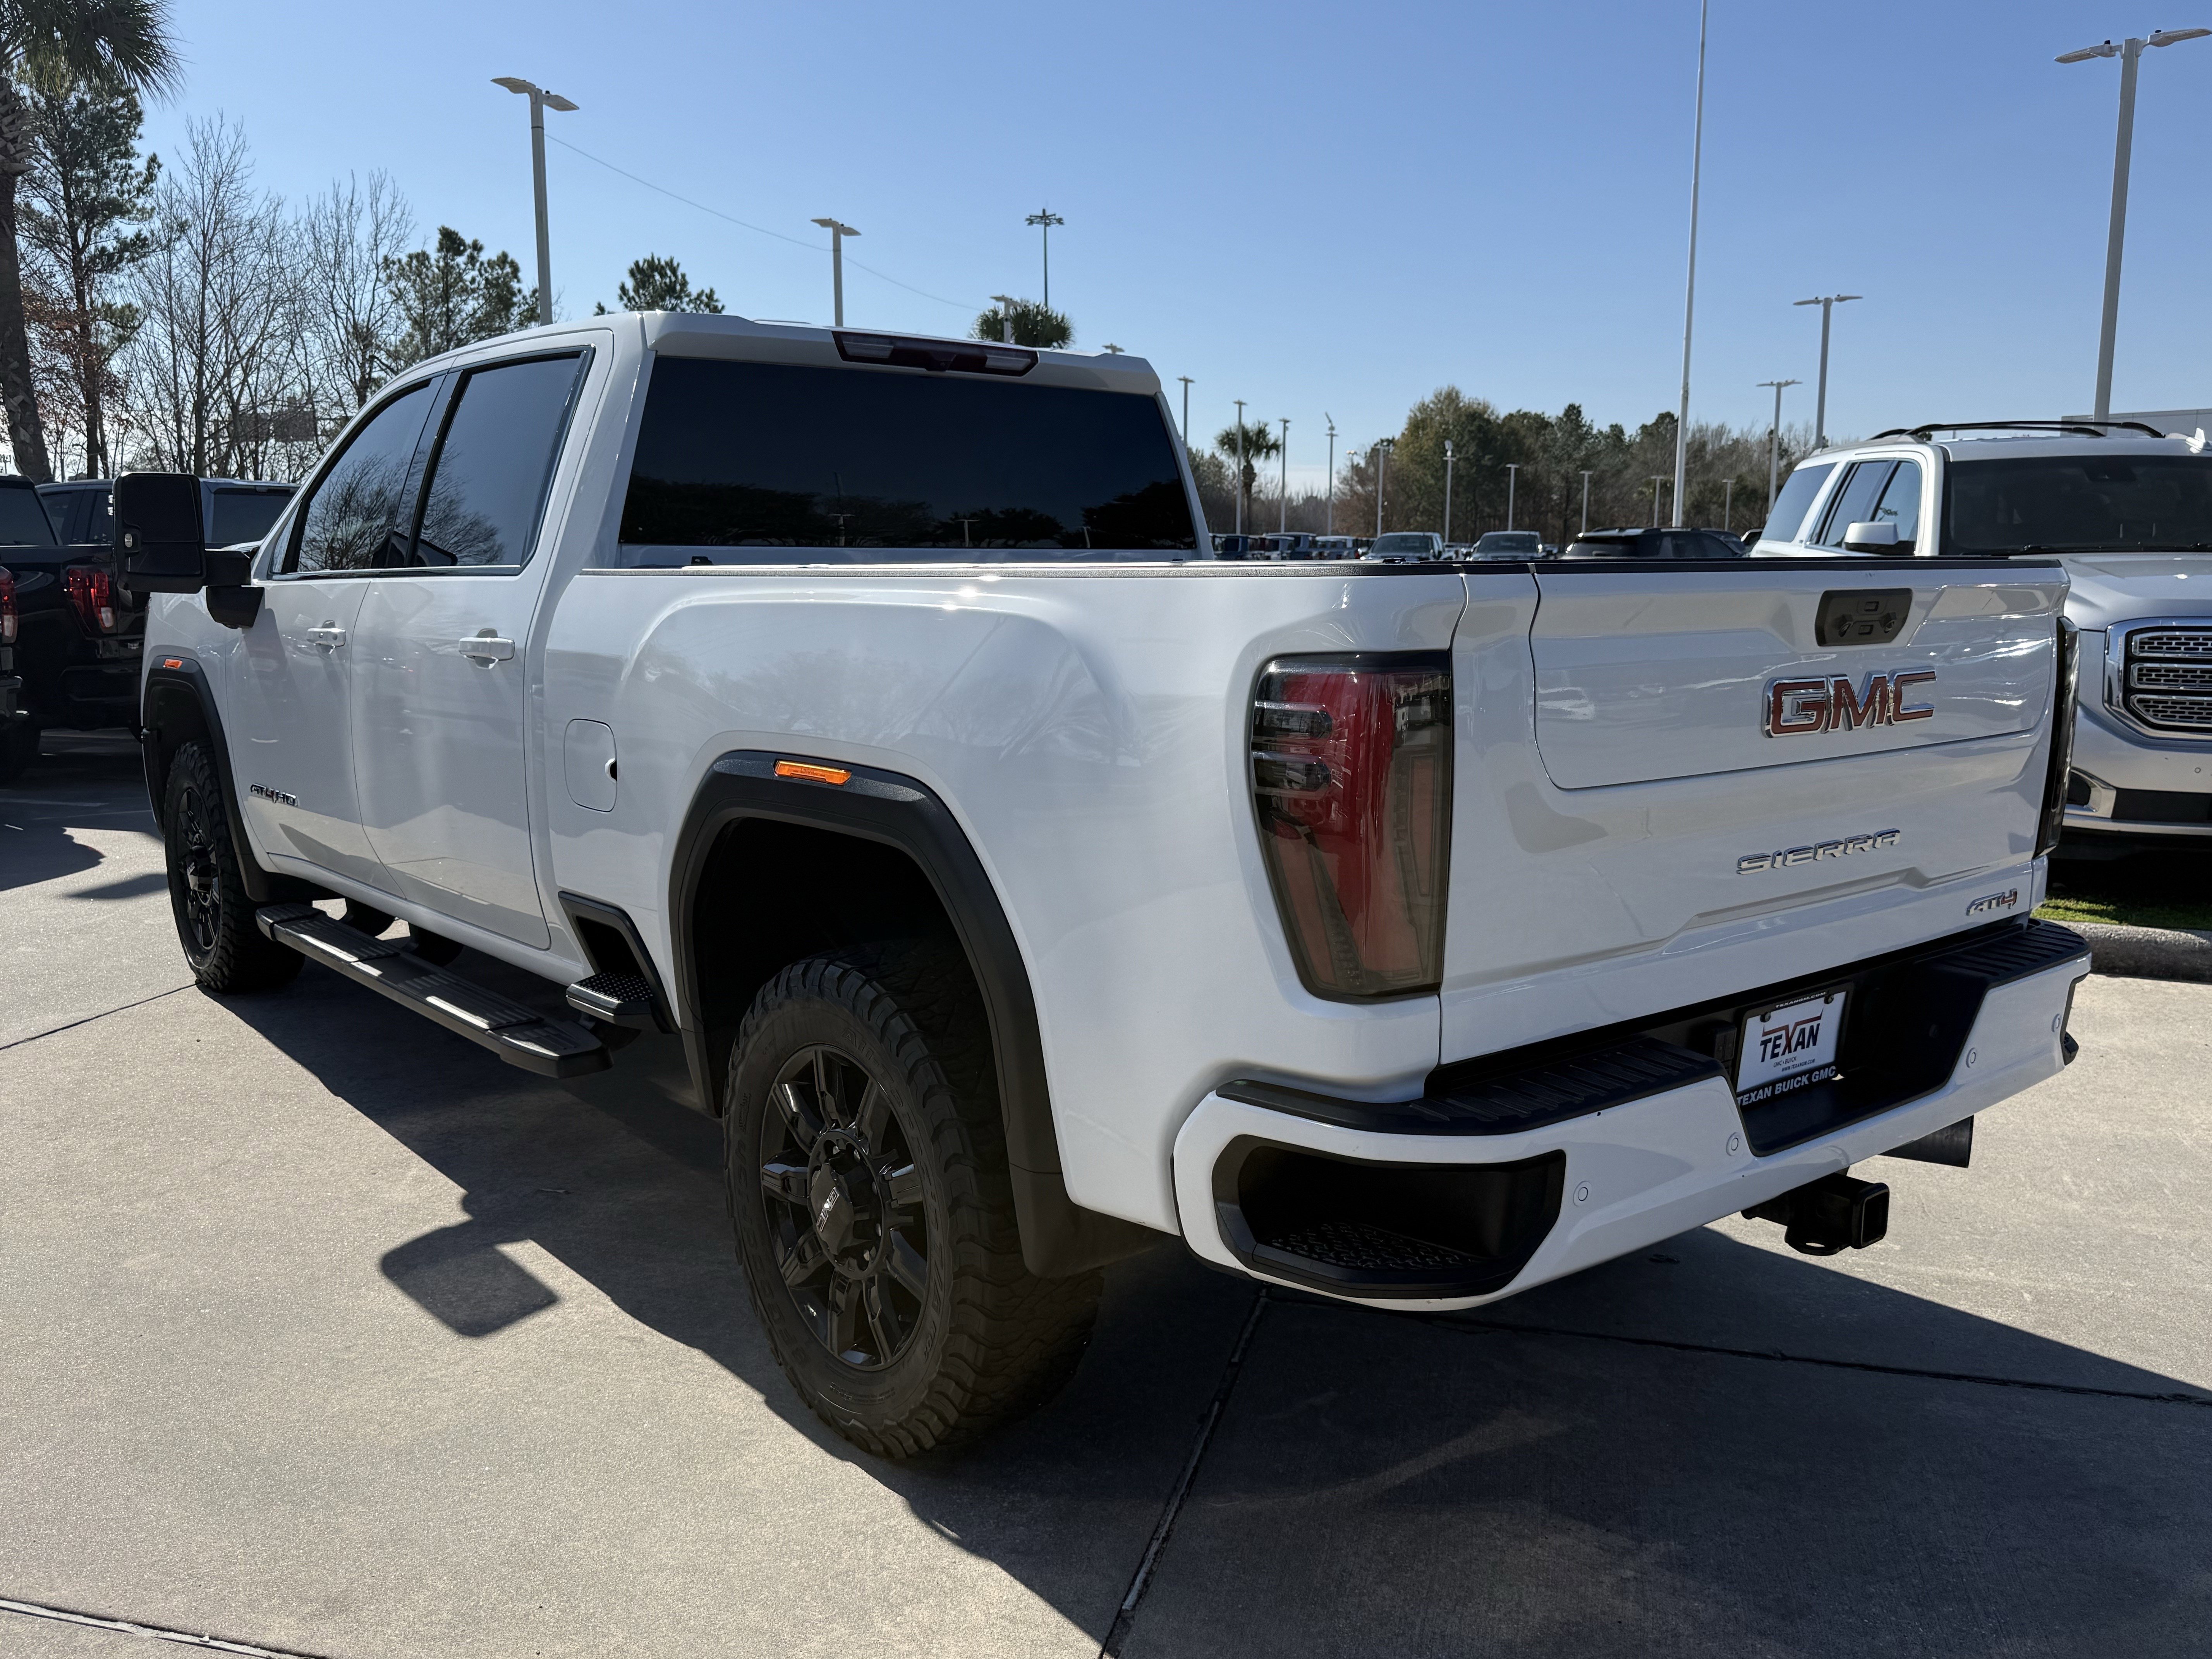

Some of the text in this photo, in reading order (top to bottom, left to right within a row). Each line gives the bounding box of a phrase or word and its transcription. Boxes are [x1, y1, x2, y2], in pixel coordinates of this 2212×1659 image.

[1761, 666, 1936, 738] GMC
[1736, 828, 1900, 875] SIERRA
[1966, 888, 2018, 915] AT4
[1776, 991, 1826, 1008] TEXANGM.COM
[1760, 1018, 1822, 1062] TEXAN
[1736, 1066, 1837, 1106] TEXAN BUICK GMC
[817, 1187, 840, 1232] GMC
